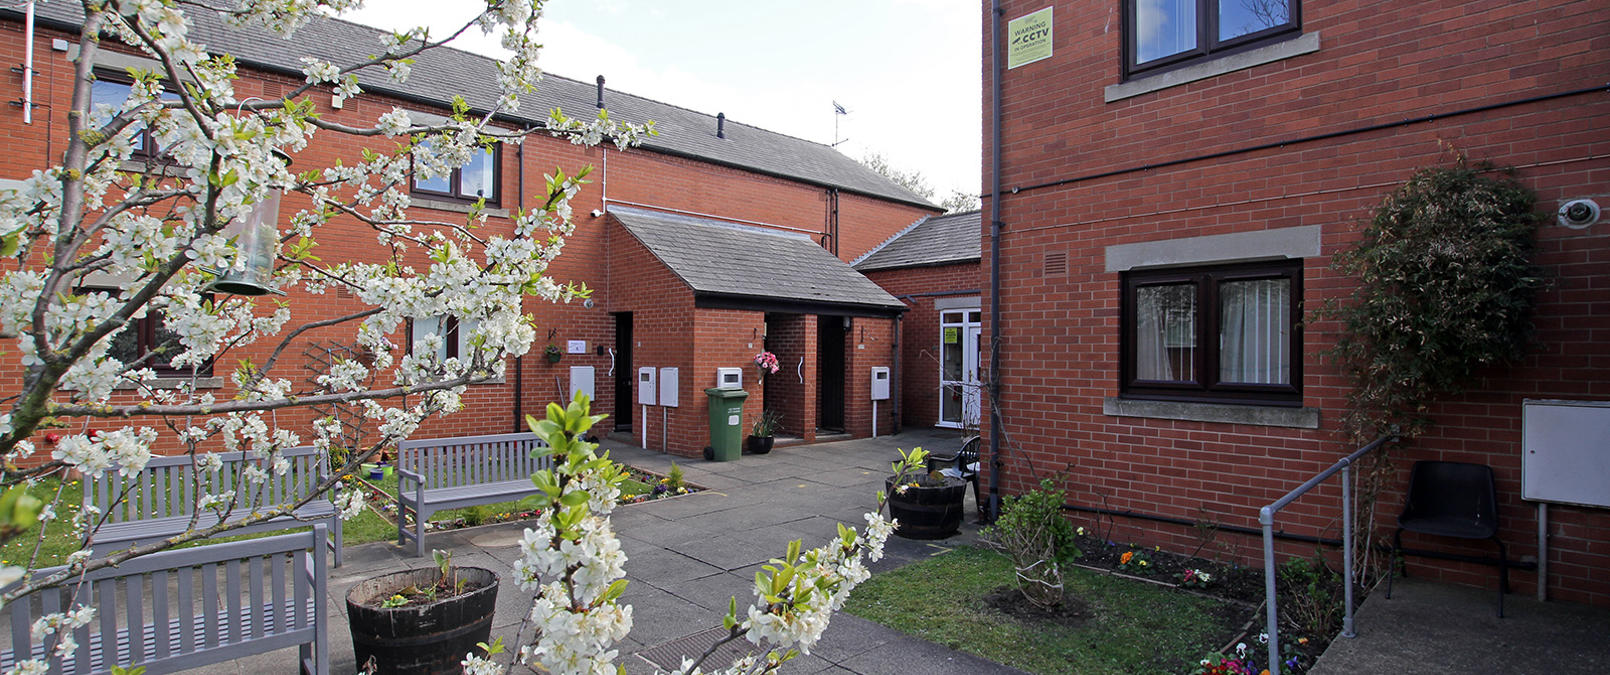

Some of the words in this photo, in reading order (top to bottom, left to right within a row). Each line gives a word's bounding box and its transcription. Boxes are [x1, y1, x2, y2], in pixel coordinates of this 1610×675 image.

[1015, 21, 1046, 36] WARNING
[1022, 28, 1049, 43] CCTV
[1020, 39, 1046, 50] OPERATION
